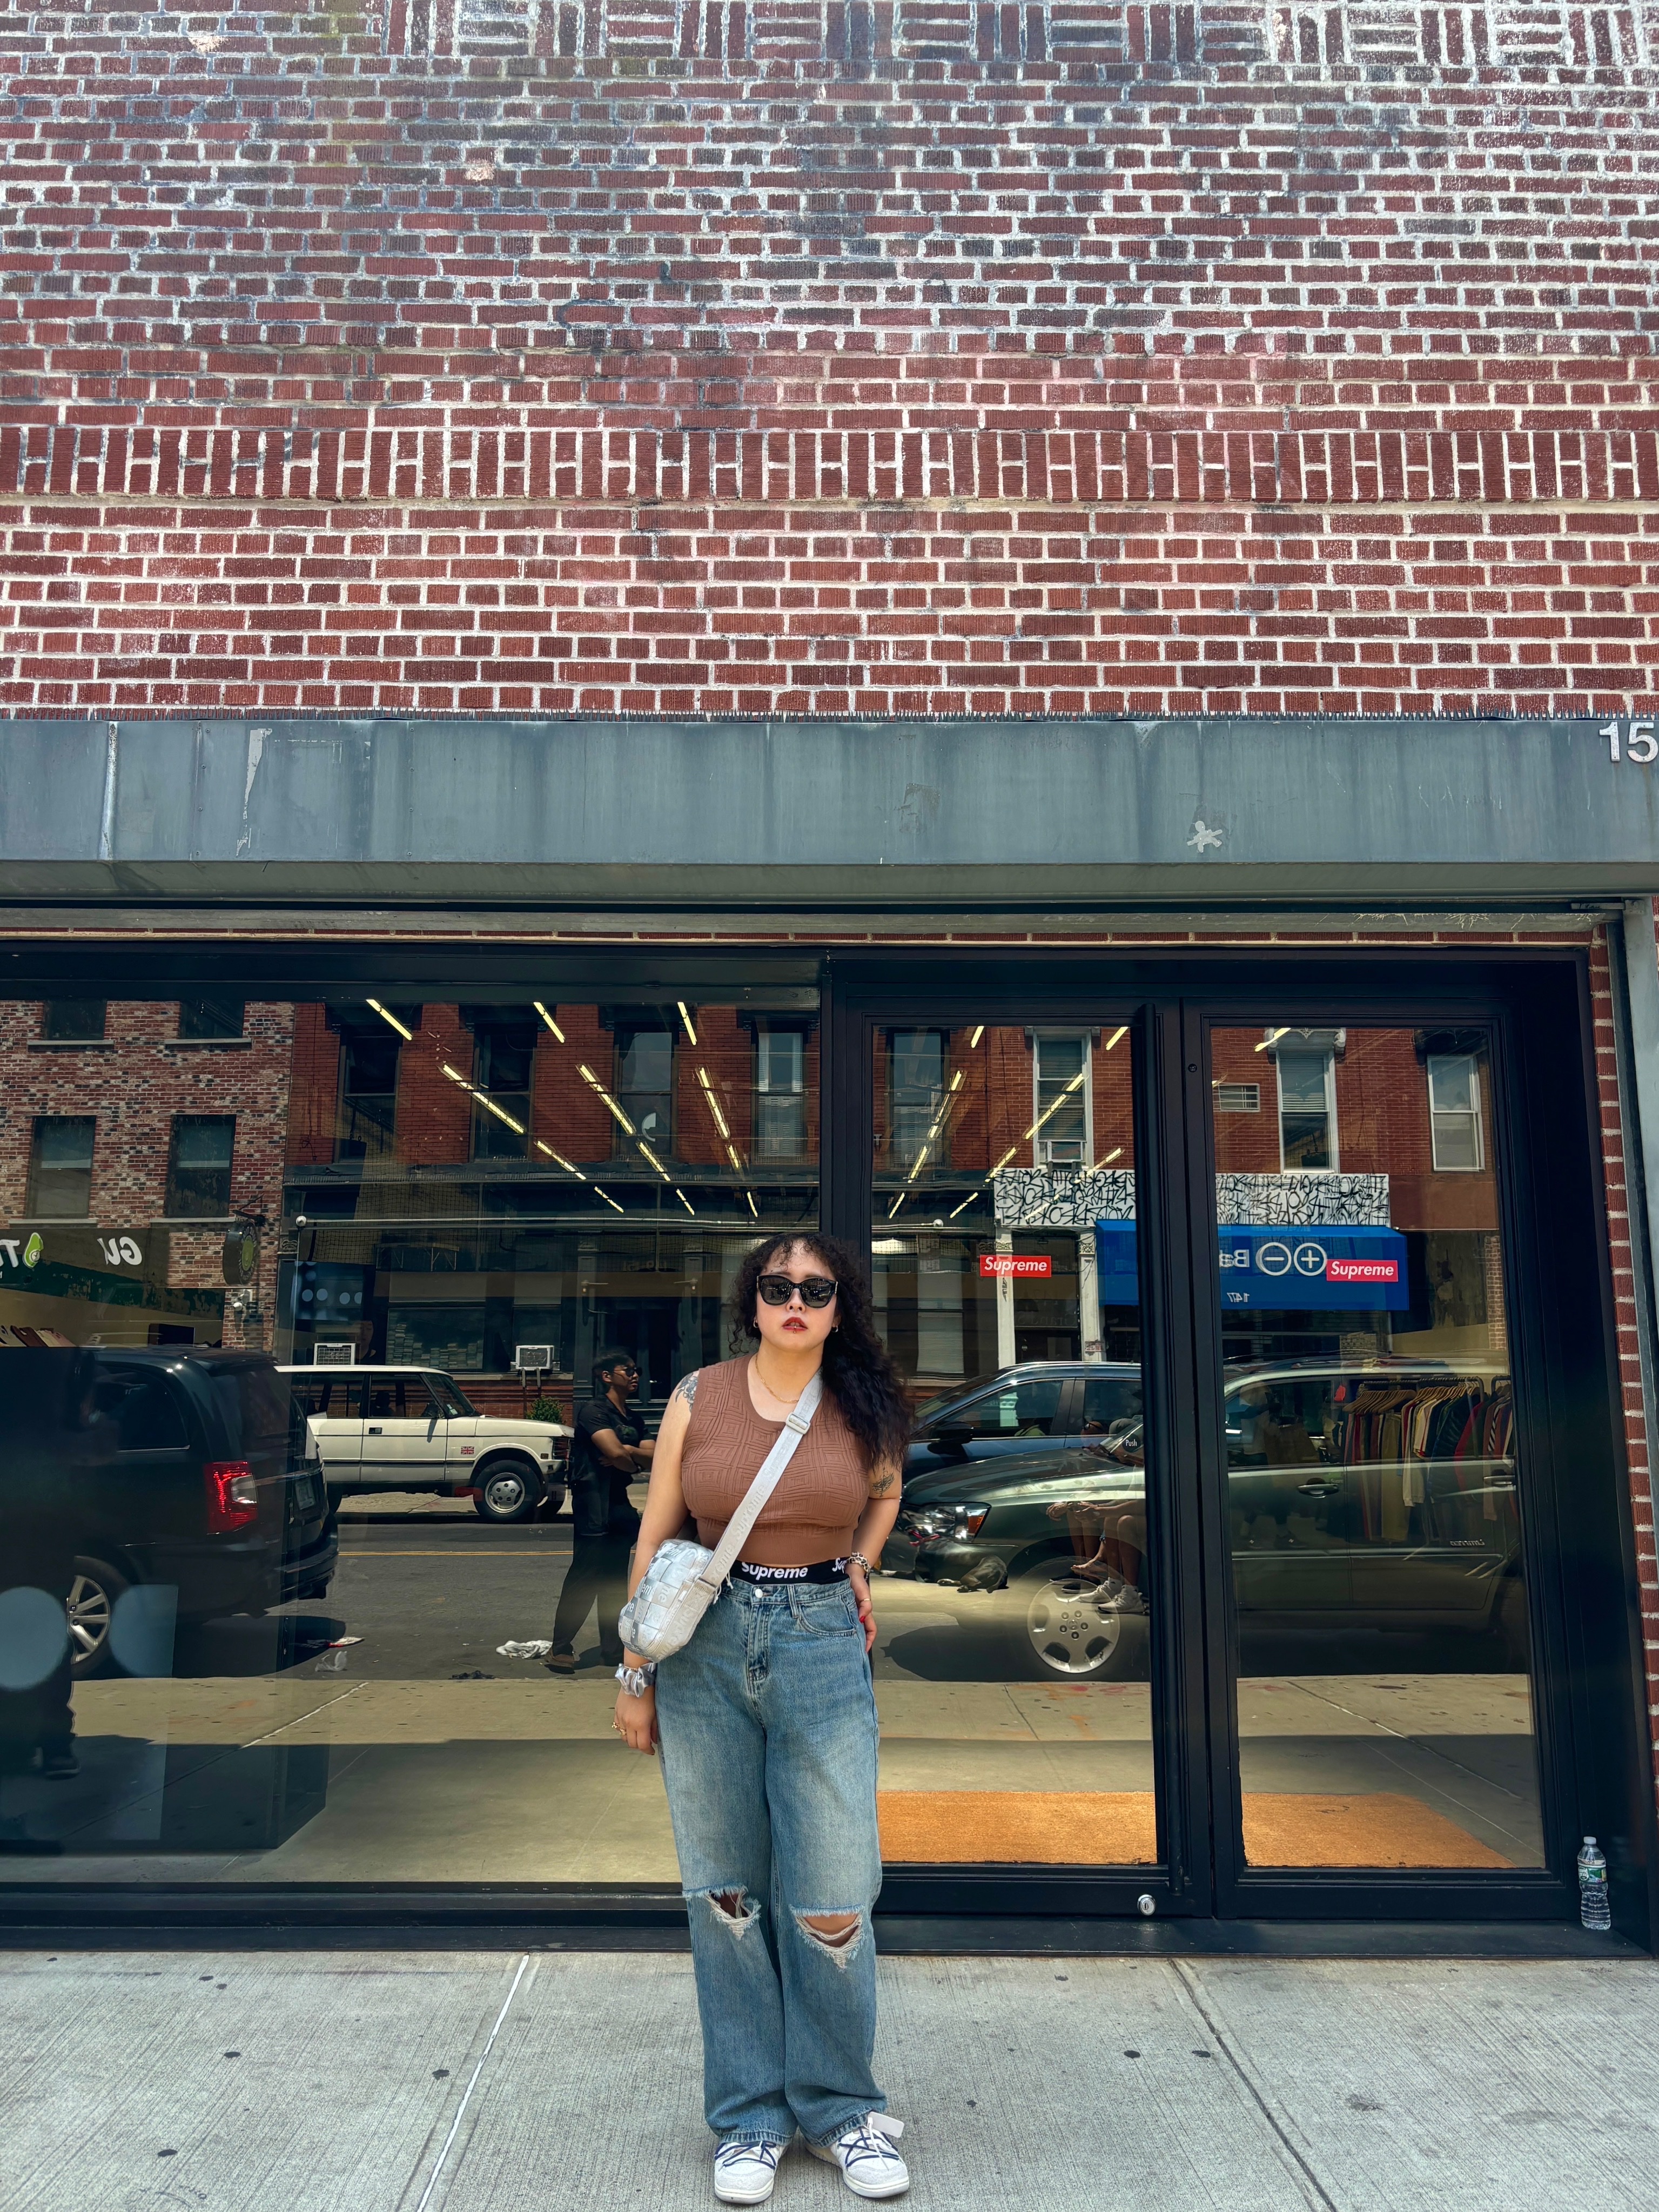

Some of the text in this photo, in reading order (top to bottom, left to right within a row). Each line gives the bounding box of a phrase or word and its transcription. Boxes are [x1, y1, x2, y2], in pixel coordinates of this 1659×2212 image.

[1599, 721, 1659, 763] 15
[984, 1256, 1047, 1275] Supreme
[1331, 1261, 1394, 1279] Supreme
[1125, 1438, 1137, 1447] Push
[741, 1562, 809, 1581] Supreme
